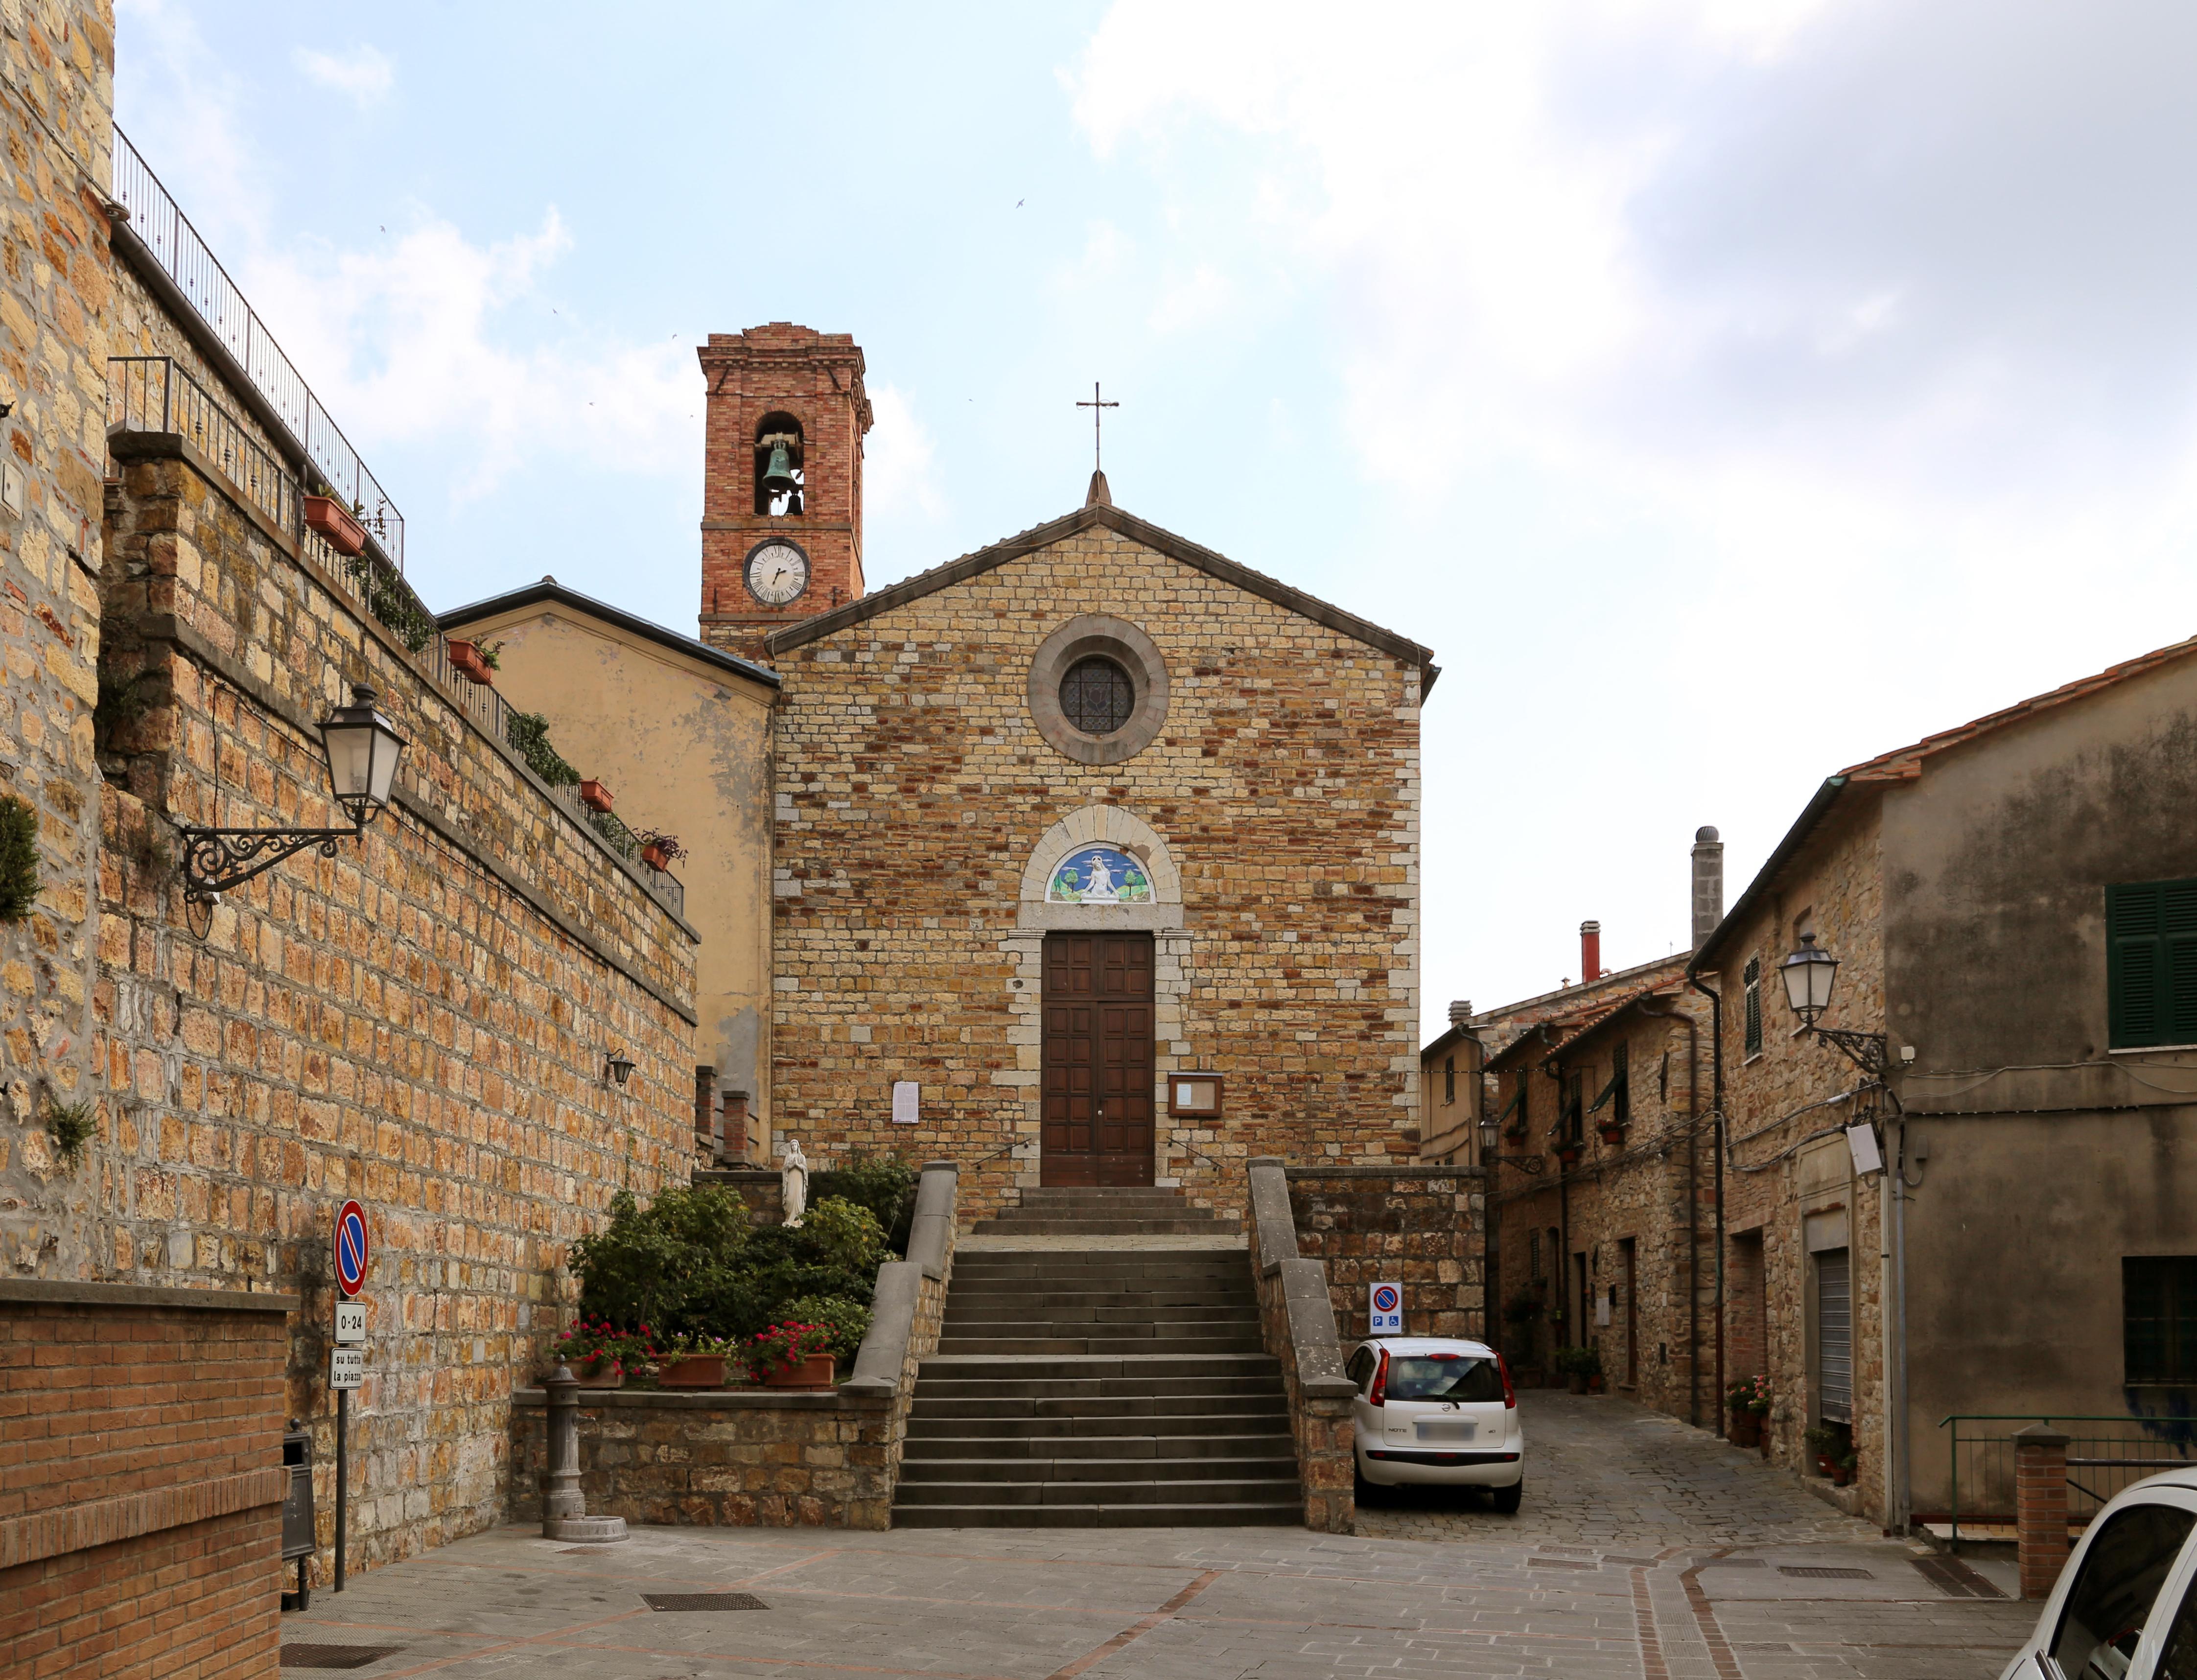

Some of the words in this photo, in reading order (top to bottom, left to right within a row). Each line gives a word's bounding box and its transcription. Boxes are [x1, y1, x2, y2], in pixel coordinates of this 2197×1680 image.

[347, 1354, 361, 1364] tutta
[334, 1371, 341, 1381] la
[344, 1371, 361, 1383] piazza
